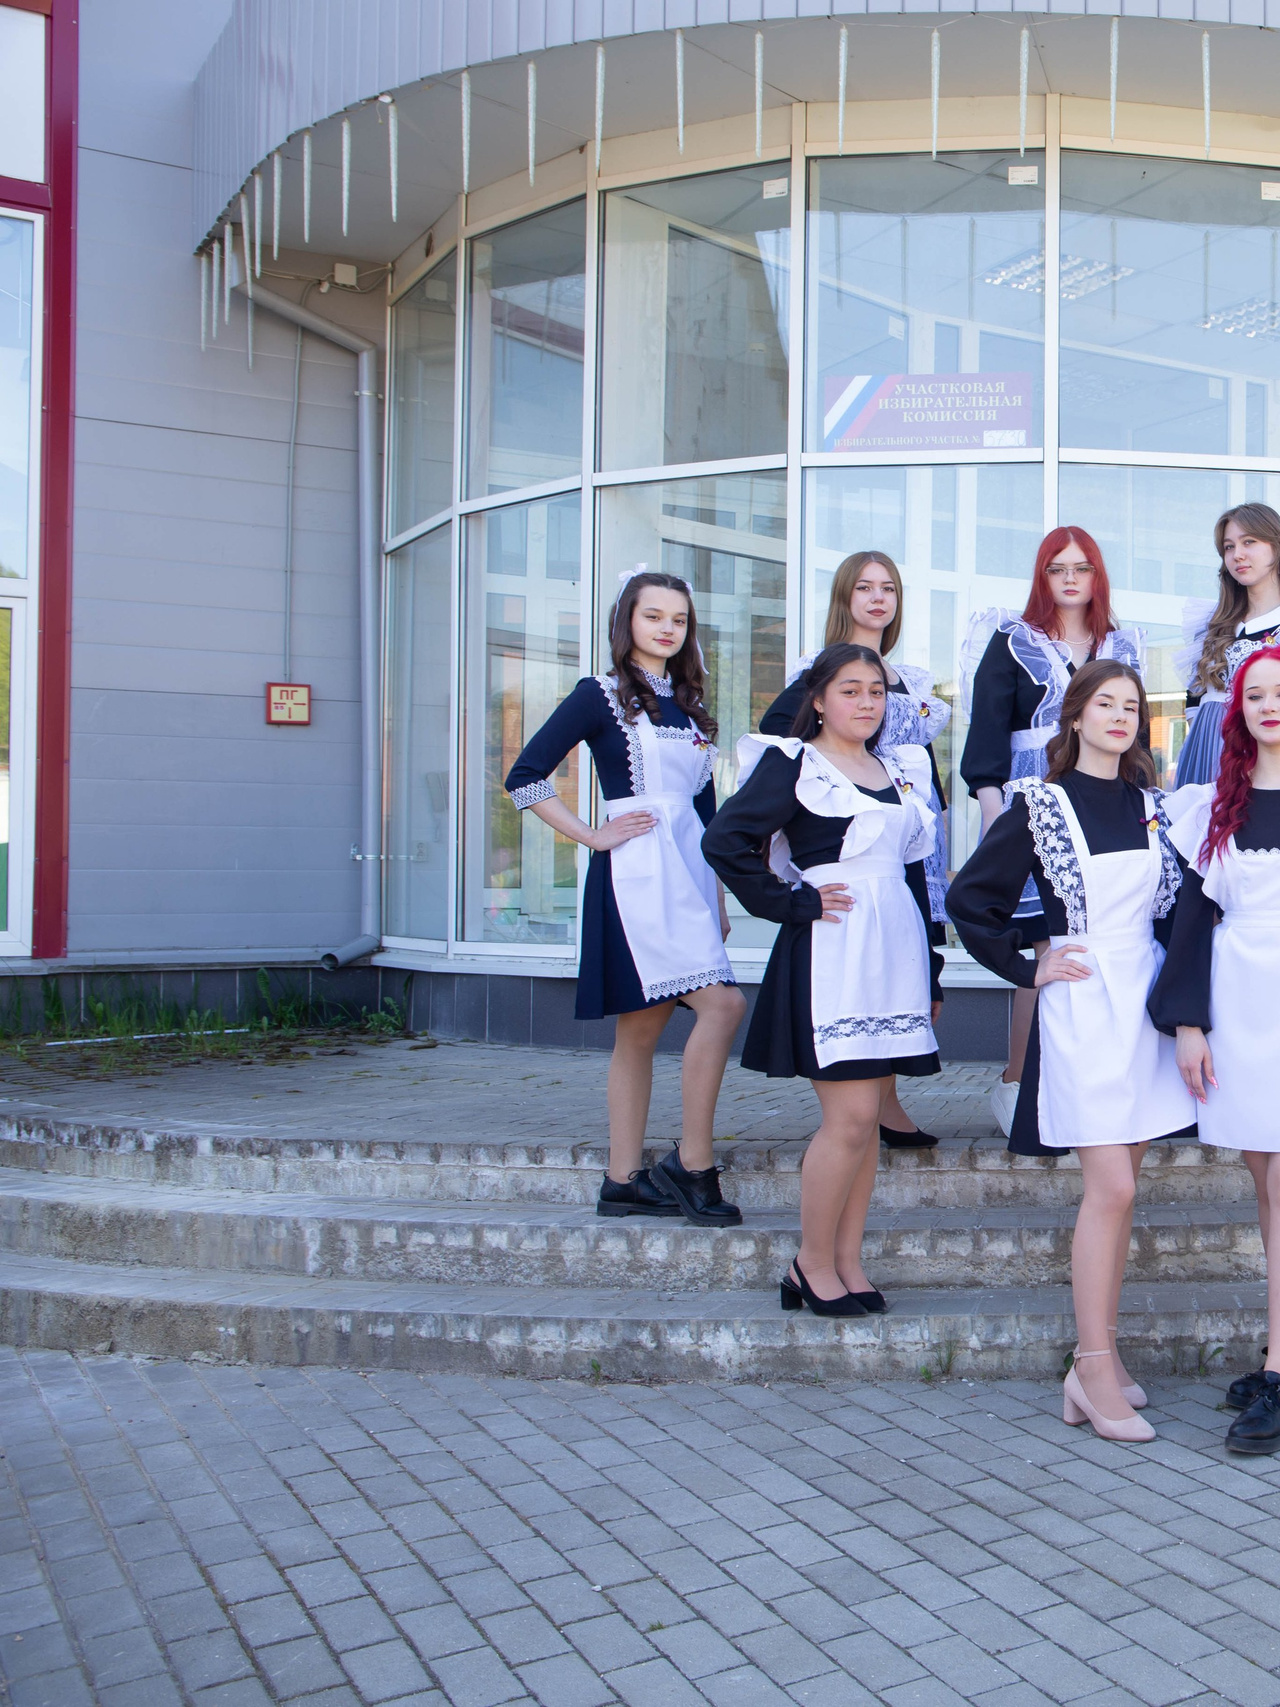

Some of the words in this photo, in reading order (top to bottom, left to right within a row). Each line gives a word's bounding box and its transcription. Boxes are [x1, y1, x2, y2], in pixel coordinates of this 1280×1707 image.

[894, 381, 1006, 396] УЧАСТКОВАЯ
[878, 395, 1023, 410] ИЗБИРАТЕЛЬНАЯ
[902, 409, 998, 423] КОМИССИЯ
[833, 435, 923, 447] ИЗБИРАТЕЛЬНОГО
[924, 434, 969, 445] УЧАСТКА
[279, 689, 299, 700] ПГ
